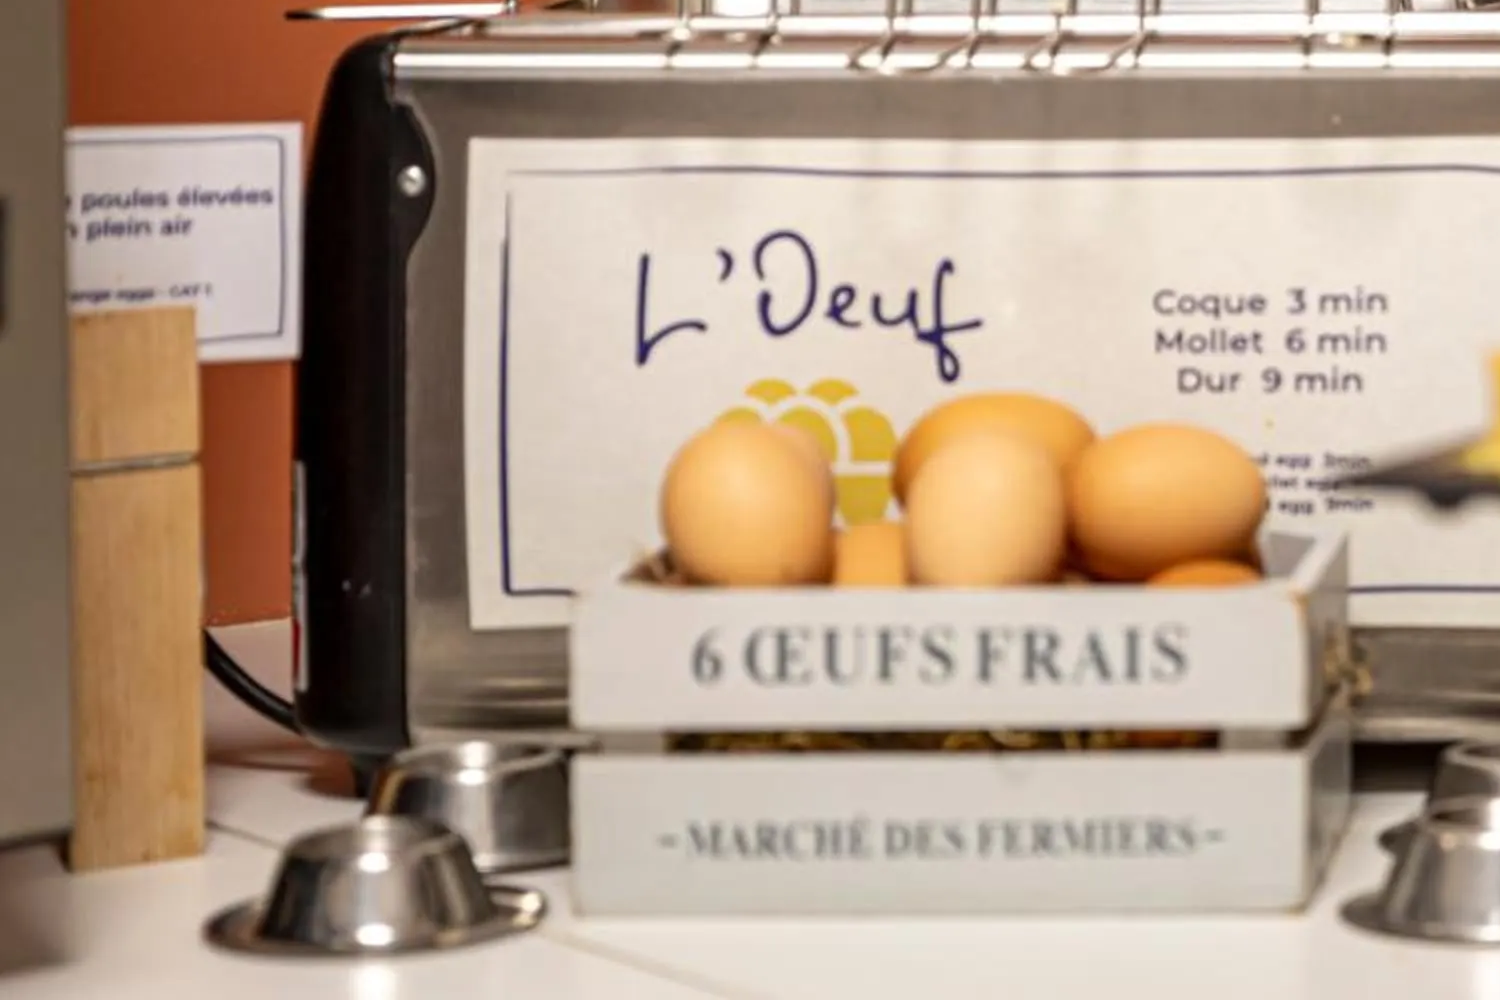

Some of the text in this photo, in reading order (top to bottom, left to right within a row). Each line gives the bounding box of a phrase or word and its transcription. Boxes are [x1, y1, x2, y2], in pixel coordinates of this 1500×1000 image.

[81, 189, 170, 214] poules
[177, 185, 273, 207] élevées
[86, 217, 151, 241] plein
[160, 216, 193, 236] air
[1152, 285, 1389, 320] Coque 3 min
[1154, 326, 1388, 354] Mollet 6 min
[1176, 365, 1365, 395] Dur 9 min
[690, 622, 1190, 687] 6 ŒUFS FRAIS
[884, 819, 965, 860] DES
